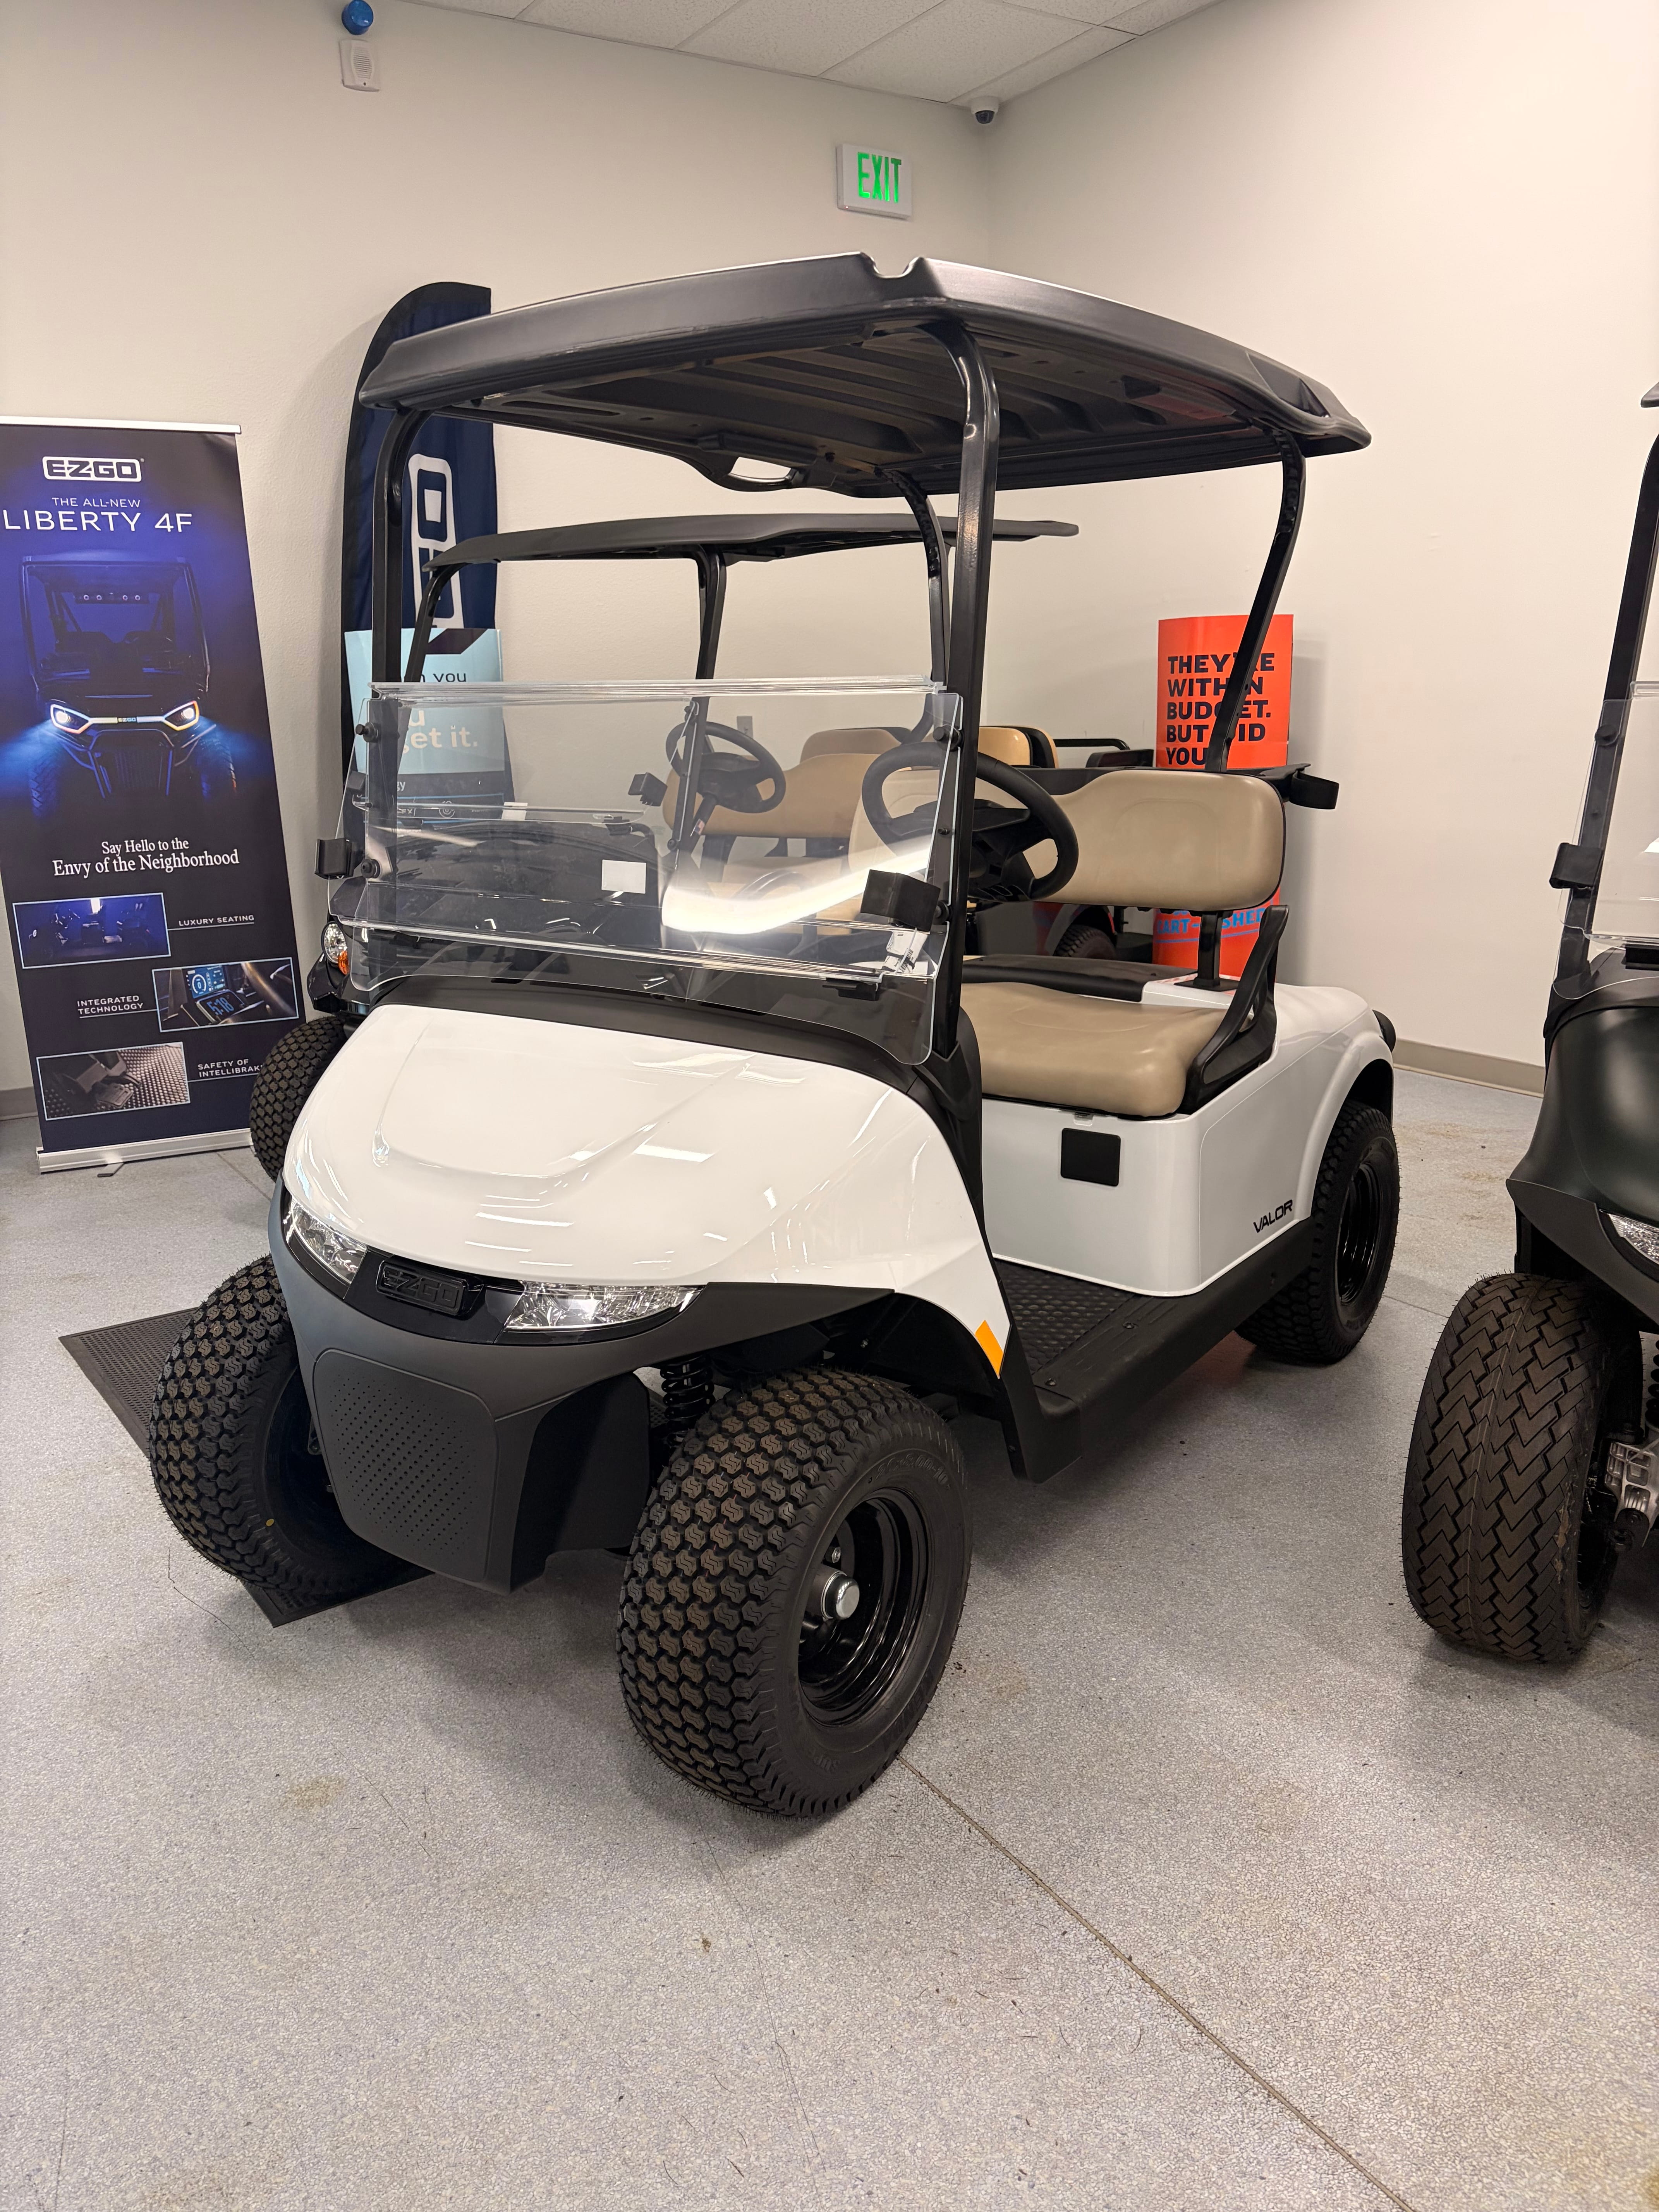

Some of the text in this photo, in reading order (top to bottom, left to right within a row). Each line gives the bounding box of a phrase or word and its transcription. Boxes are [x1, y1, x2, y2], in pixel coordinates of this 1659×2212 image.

[857, 152, 902, 203] EXIT
[46, 459, 137, 479] EZGO
[52, 497, 140, 508] THE ALL-NEW
[3, 509, 192, 532] LIBERTY 4F
[1168, 652, 1275, 674] THEY'E
[1167, 677, 1264, 697] WITHN
[1167, 700, 1271, 720] BUDET.
[450, 725, 478, 747] it.
[1167, 723, 1266, 743] BUT ID
[1166, 747, 1208, 765] YOU
[101, 837, 189, 856] Say Hello to the
[52, 848, 240, 878] Envy of the Neighborhood
[178, 914, 255, 927] LUXURY SEATING
[77, 995, 139, 1007] INTEGRATED
[77, 1002, 143, 1015] TECHNOLOGY
[206, 997, 234, 1015] 5:18
[198, 1060, 234, 1070] SAFETY
[199, 1065, 263, 1078] INTELLIBRAK
[1253, 1199, 1293, 1233] VALOR
[383, 1266, 459, 1309] EZGO
